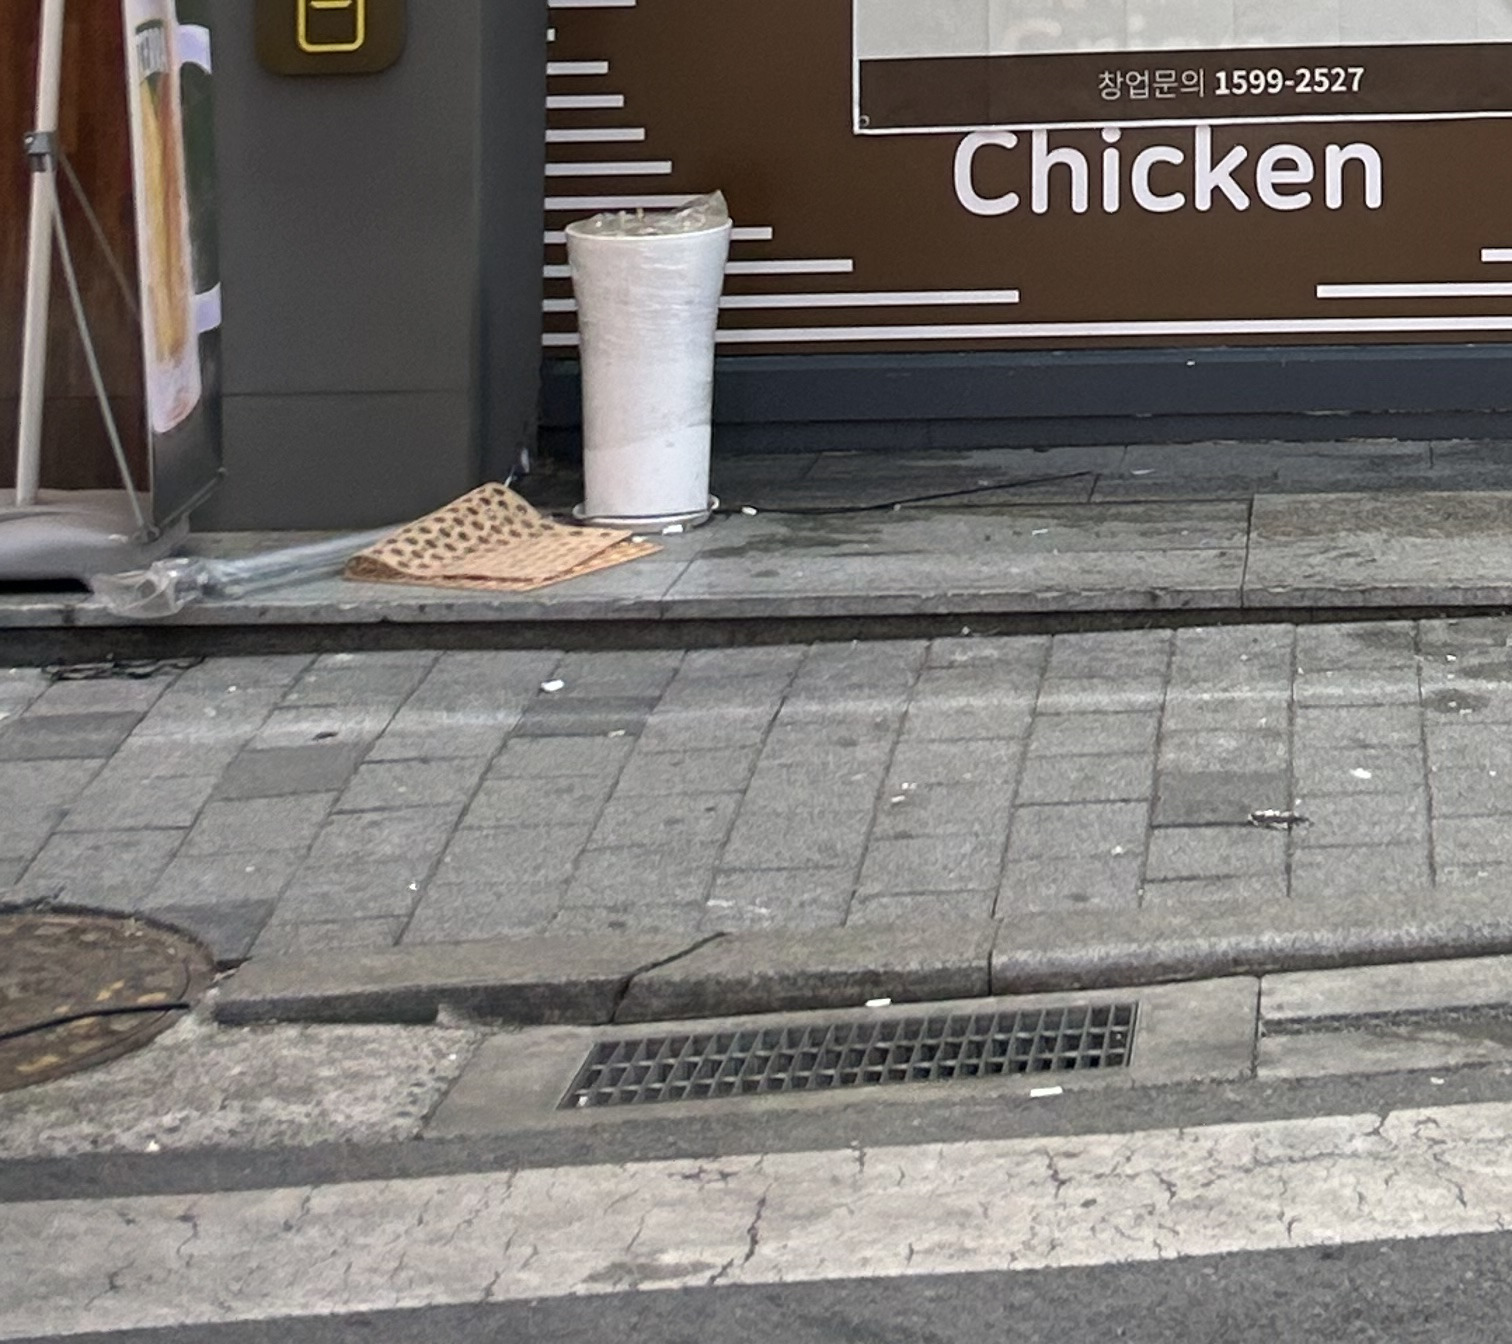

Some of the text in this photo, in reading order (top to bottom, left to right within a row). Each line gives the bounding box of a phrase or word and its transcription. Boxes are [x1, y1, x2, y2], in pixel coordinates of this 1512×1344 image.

[1098, 67, 1365, 100] 창업문의 1599-2527
[952, 123, 1385, 217] Chicken
